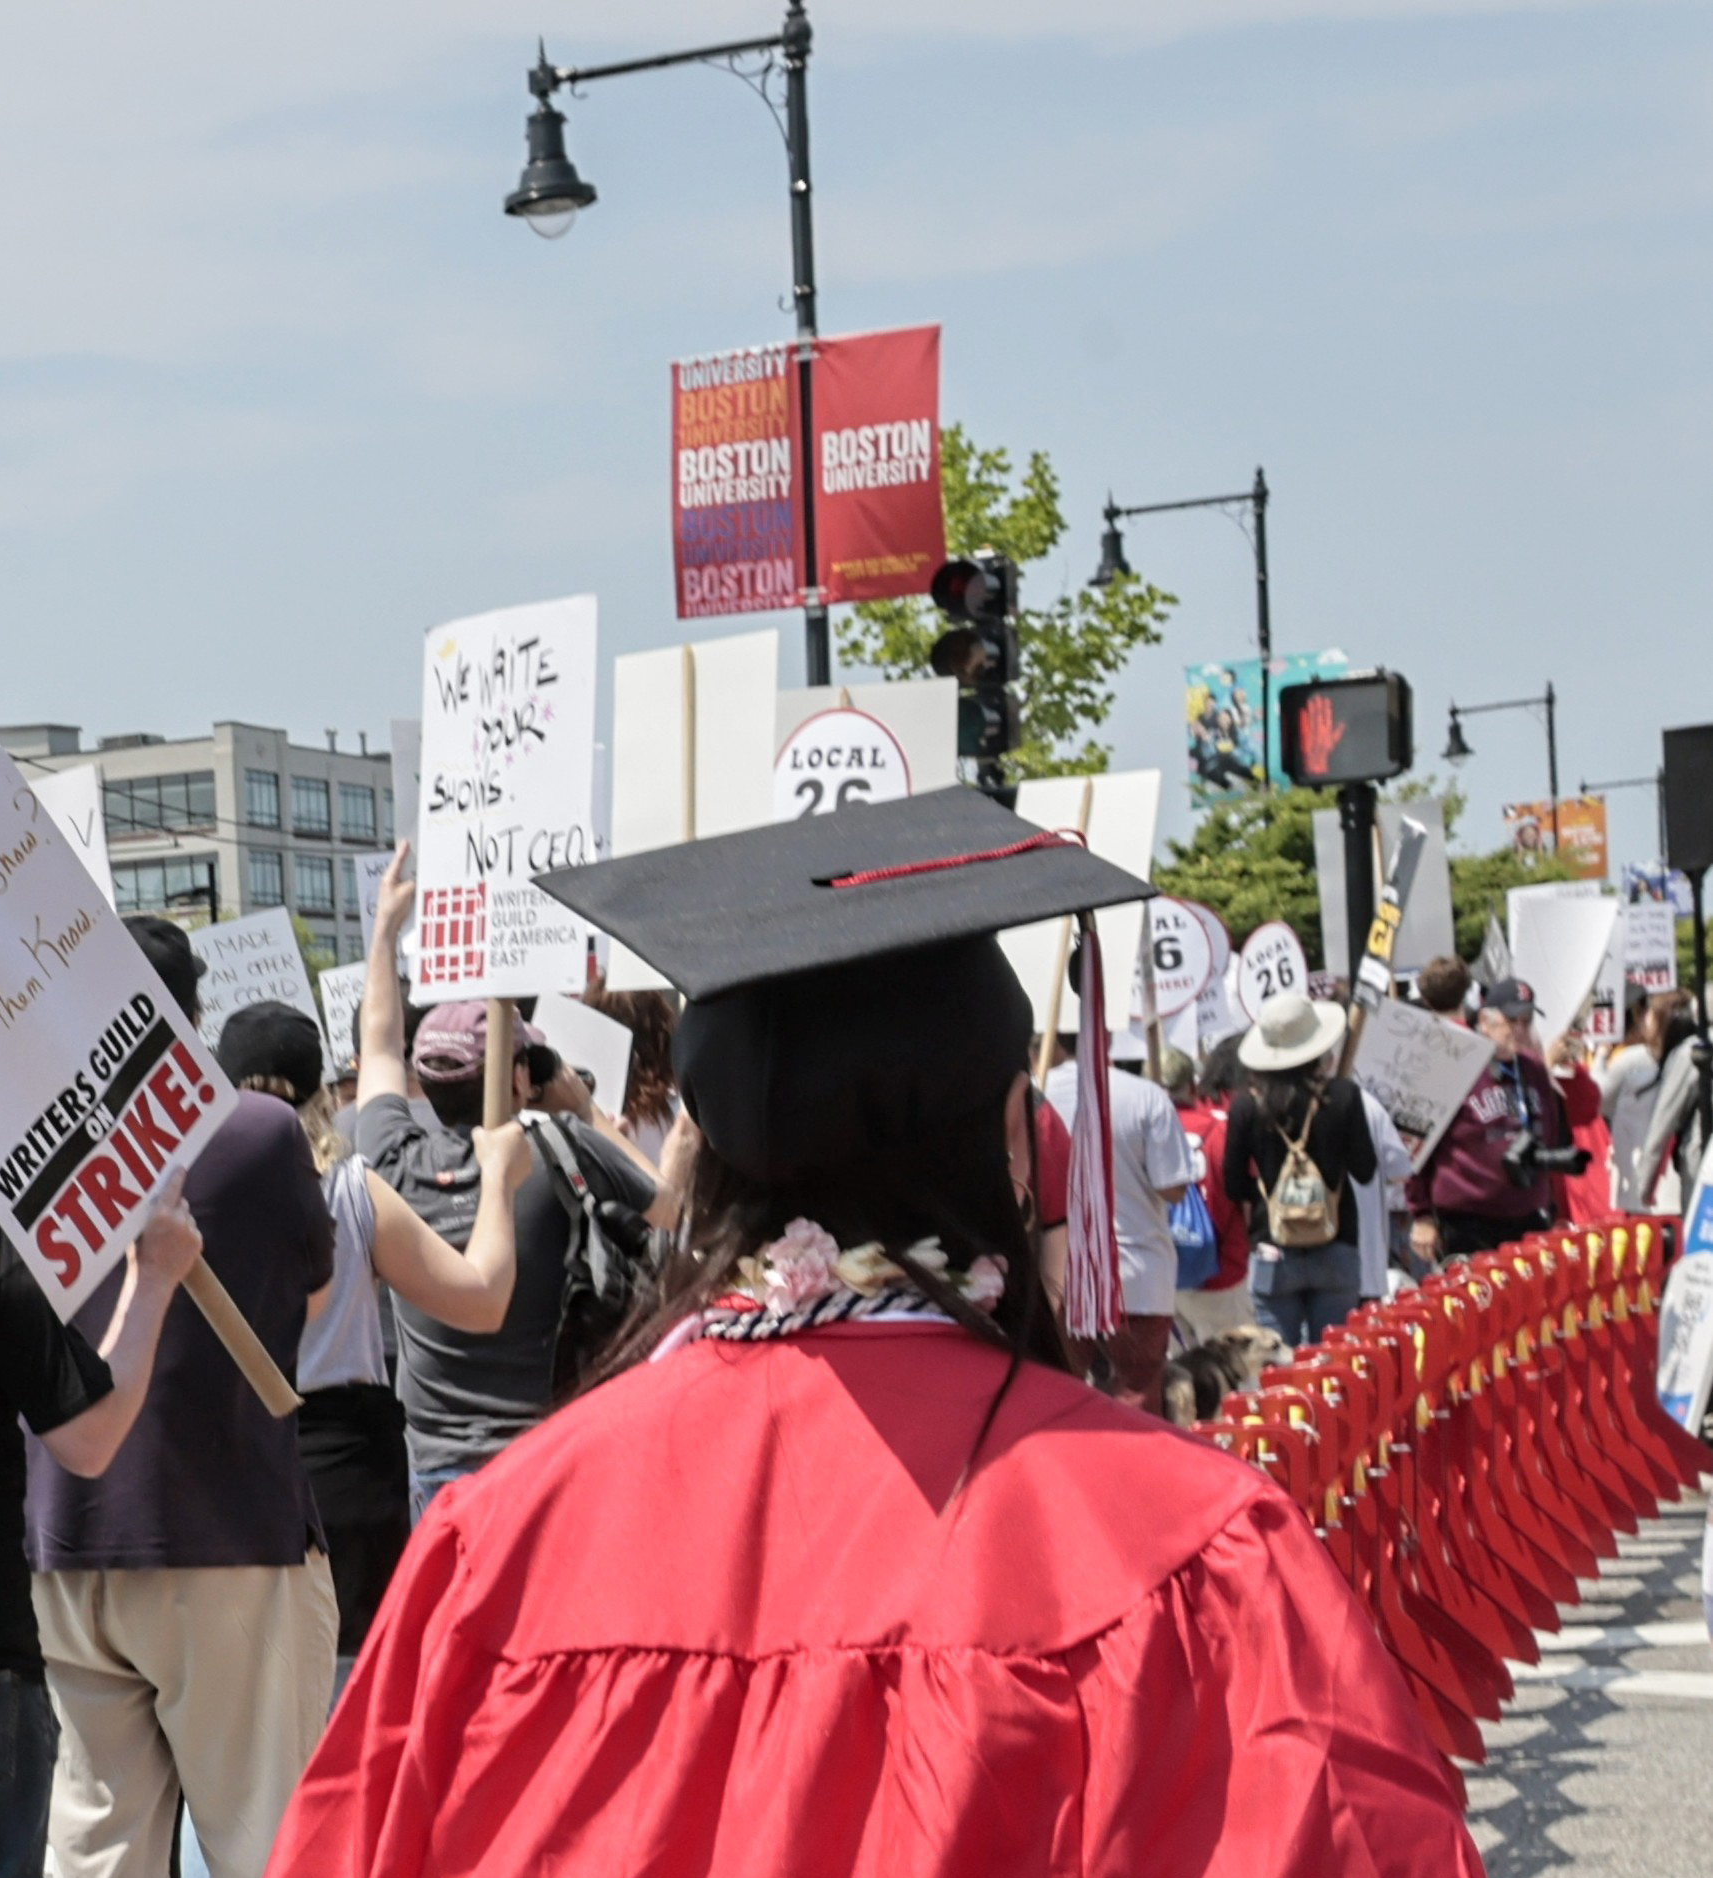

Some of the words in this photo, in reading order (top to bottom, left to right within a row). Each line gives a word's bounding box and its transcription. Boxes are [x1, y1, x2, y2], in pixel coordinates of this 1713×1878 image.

[679, 351, 788, 391] UNIVERSITY
[681, 377, 788, 424] BOSTON
[680, 414, 788, 447] UNIVERSITY
[821, 418, 931, 469] BOSTON
[678, 437, 791, 484] BOSTON
[823, 458, 931, 494] UNIVERSITY
[679, 474, 791, 509] UNIVERSITY
[682, 501, 793, 543] BOSTON
[682, 535, 793, 566] UNIVERSITY
[682, 557, 795, 603] BOSTON
[481, 701, 546, 761] YOUR
[790, 745, 887, 770] LOCAL
[466, 820, 524, 878] NOT
[491, 910, 538, 930] GUILD
[506, 926, 578, 949] AMERICA
[490, 950, 529, 968] EAST
[1255, 956, 1296, 1000] 26
[88, 991, 157, 1083] GUILD
[84, 1101, 116, 1142] ON
[35, 1039, 216, 1291] STRIKE!
